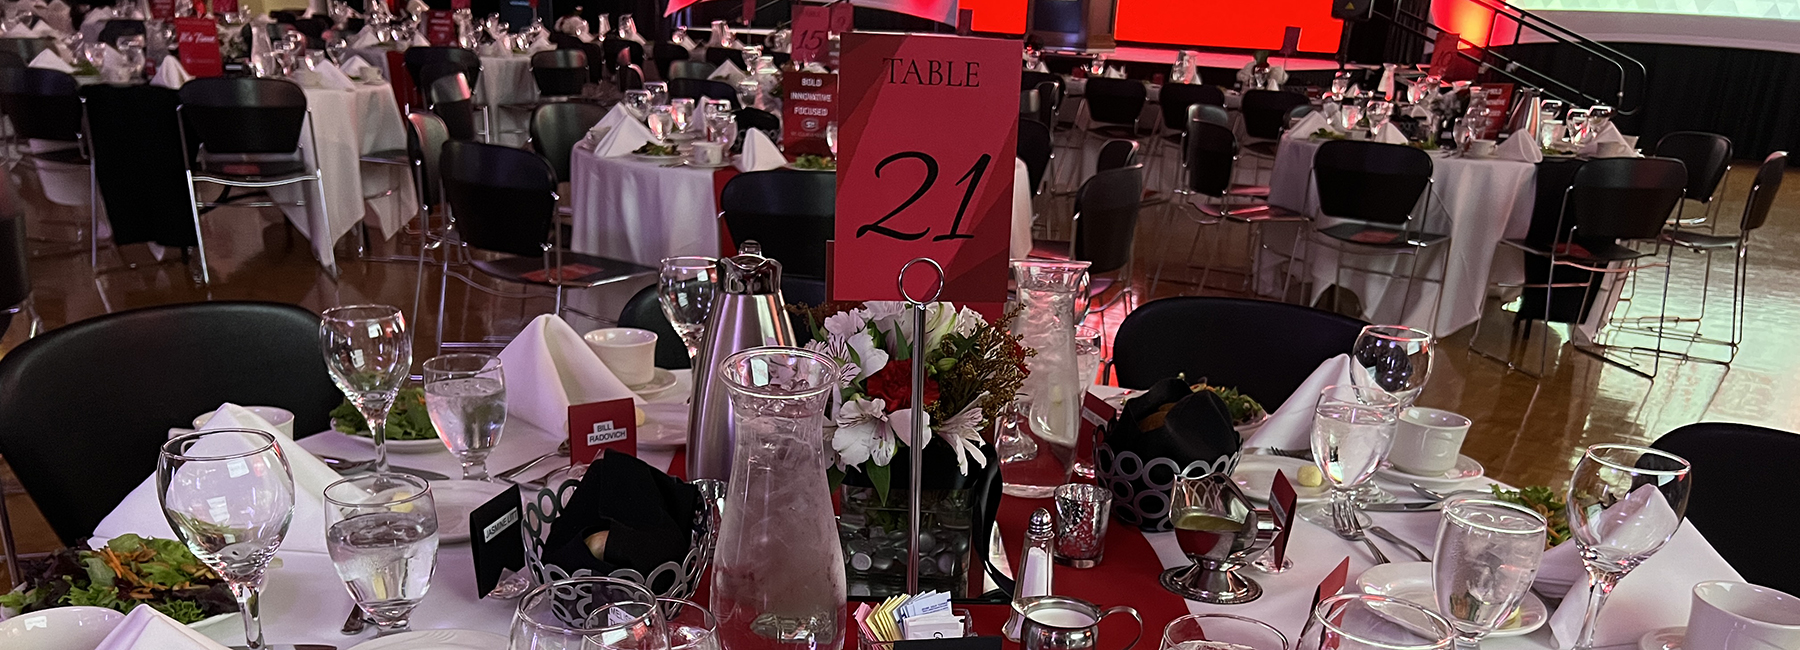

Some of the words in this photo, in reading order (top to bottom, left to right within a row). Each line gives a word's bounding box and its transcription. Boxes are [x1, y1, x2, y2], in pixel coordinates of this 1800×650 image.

[795, 30, 824, 50] 15
[882, 57, 980, 87] TABLE
[801, 77, 823, 87] BOLD
[790, 92, 832, 102] INNOVATIVE
[794, 106, 828, 116] FOCUSED
[856, 151, 992, 242] 21
[597, 423, 612, 433] BILL
[589, 431, 626, 443] RADOVICH
